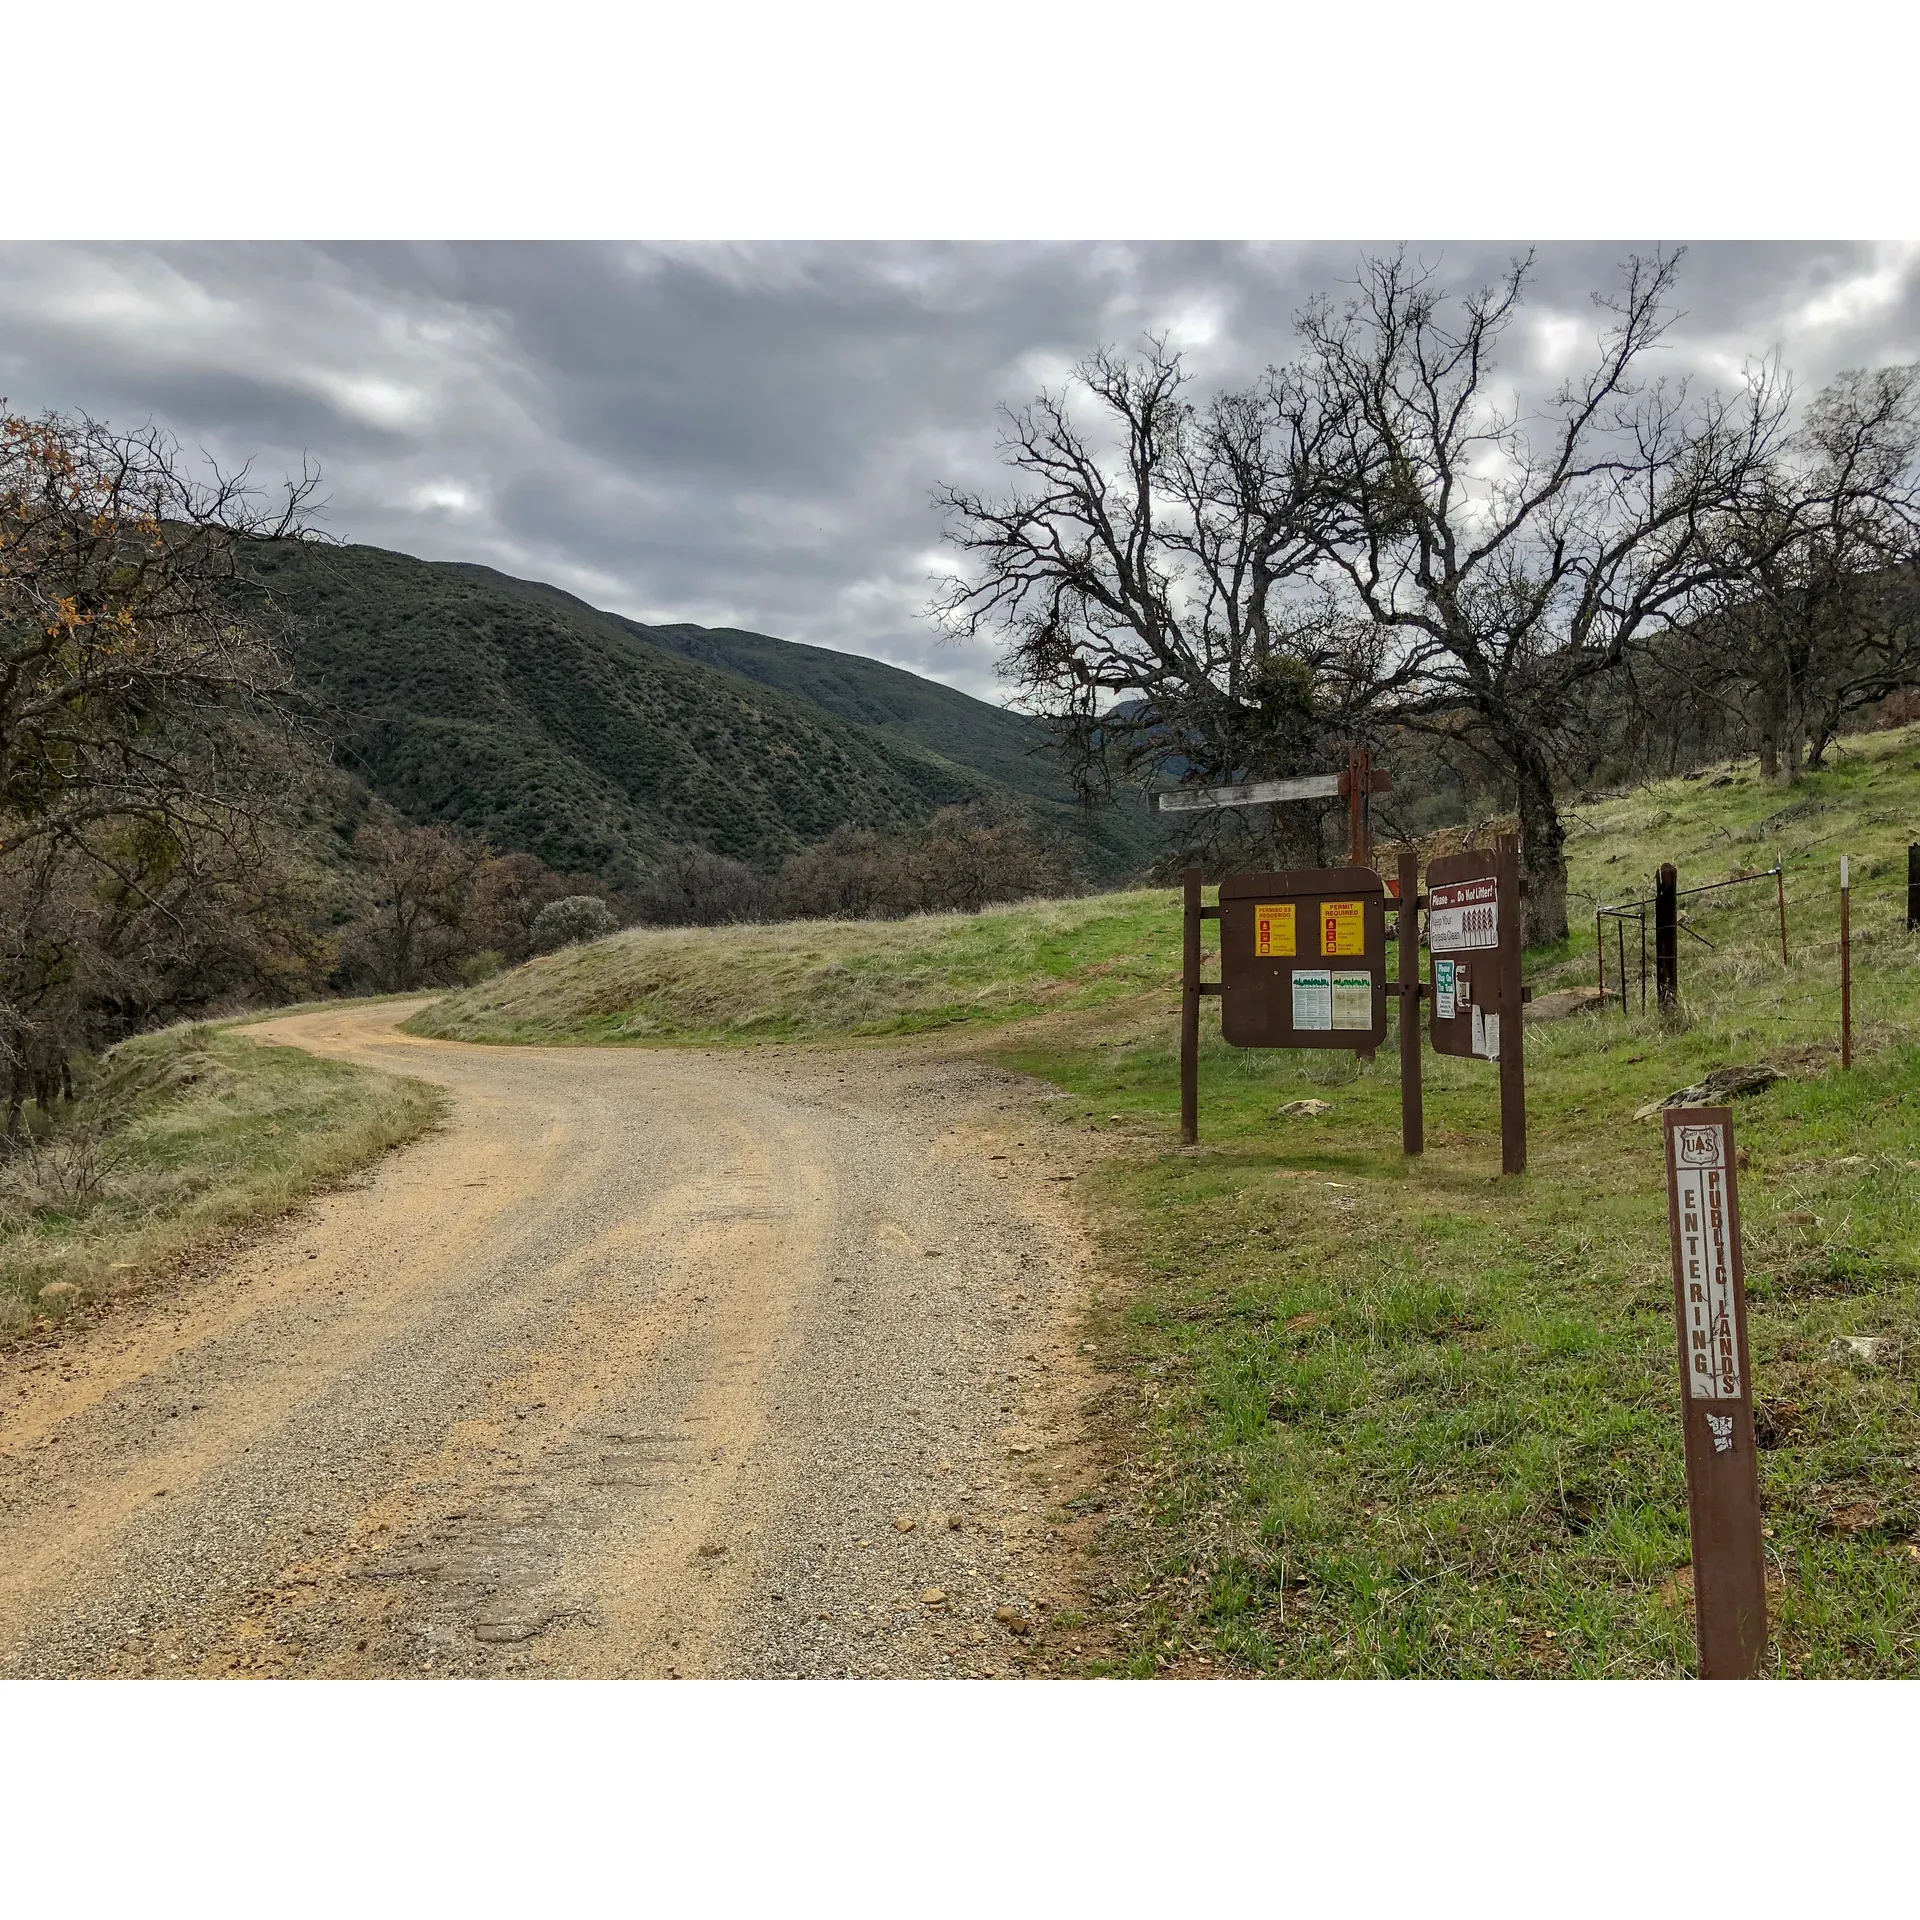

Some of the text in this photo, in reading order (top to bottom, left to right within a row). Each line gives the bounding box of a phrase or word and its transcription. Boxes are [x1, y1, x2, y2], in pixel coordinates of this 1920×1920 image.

[1432, 895, 1448, 906] Please
[1457, 890, 1464, 903] Do
[1465, 888, 1475, 901] Not
[1475, 885, 1493, 899] Litter!
[1684, 1189, 1708, 1374] ENTERING
[1708, 1171, 1727, 1285] PUBLIC
[1718, 1300, 1735, 1394] LANDS
